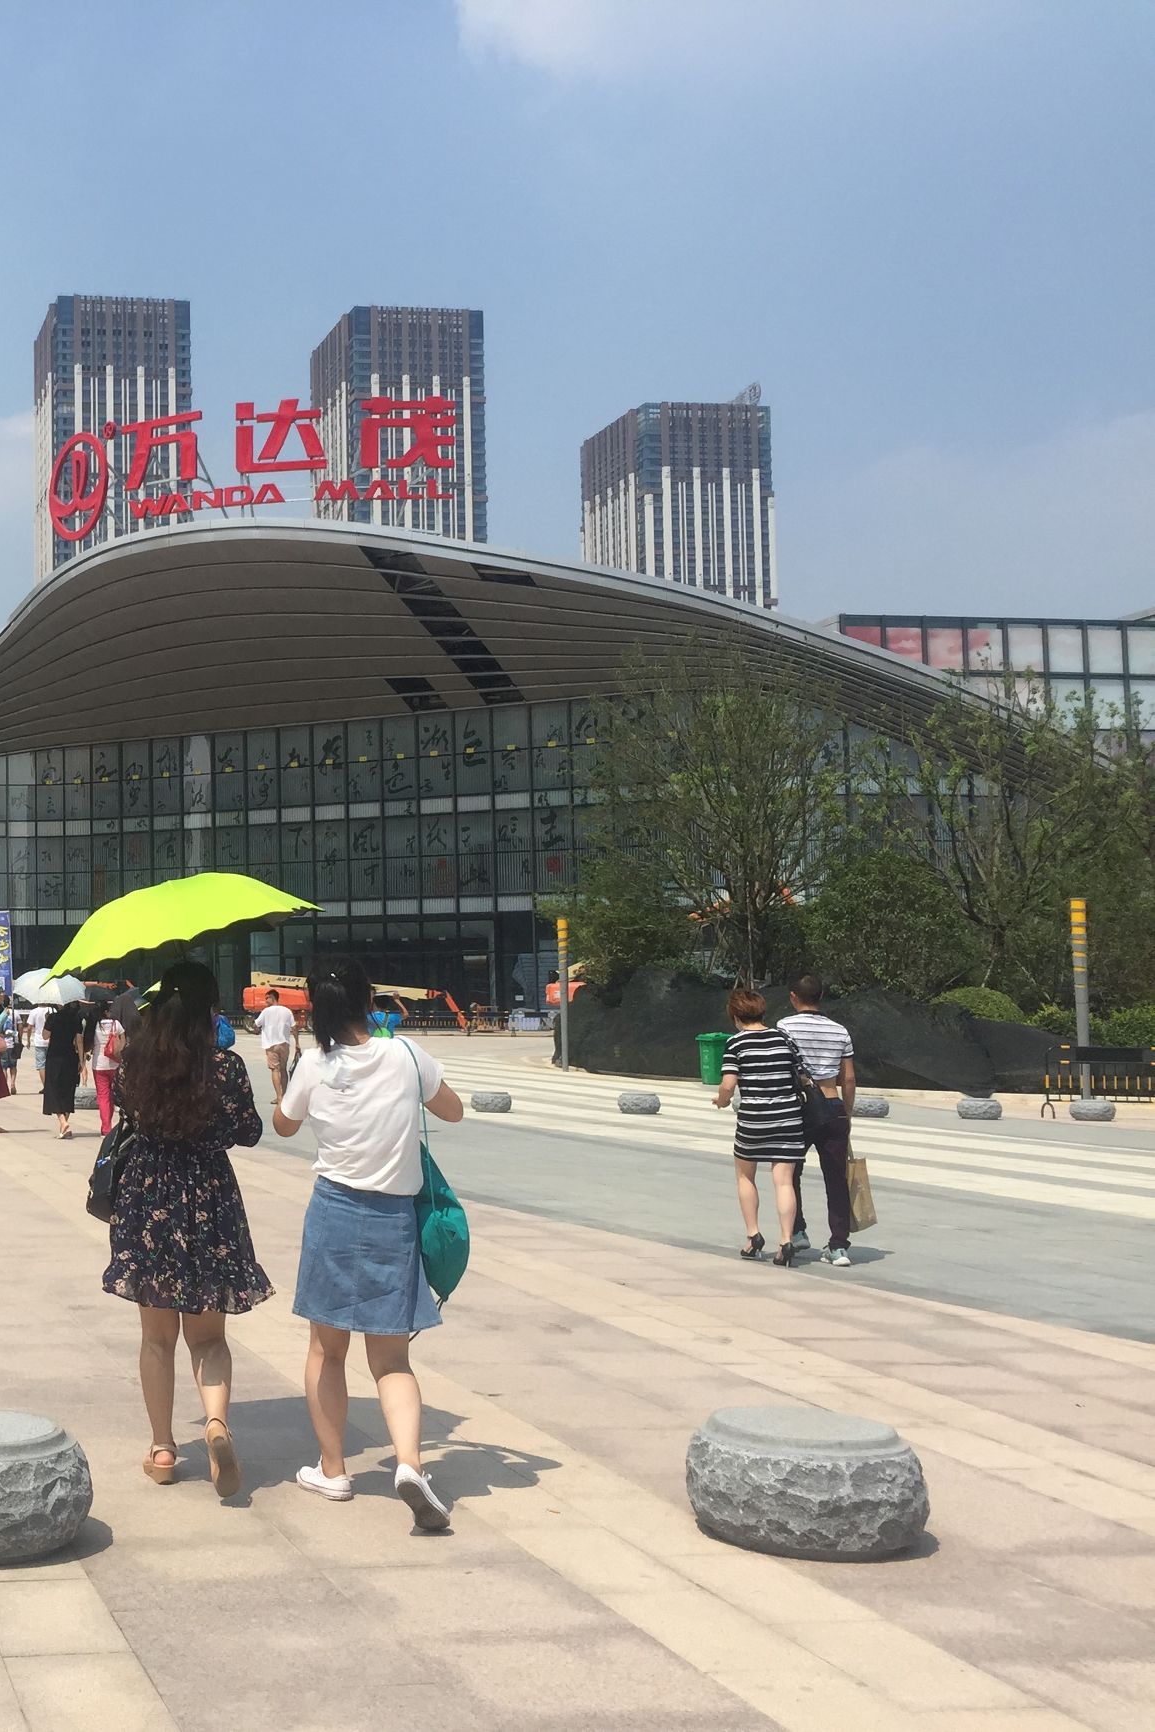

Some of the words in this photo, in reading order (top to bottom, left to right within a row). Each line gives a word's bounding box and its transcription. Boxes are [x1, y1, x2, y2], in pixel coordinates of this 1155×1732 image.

[121, 396, 455, 491] 万达茂
[126, 483, 286, 518] WANDA
[313, 478, 454, 501] MALL
